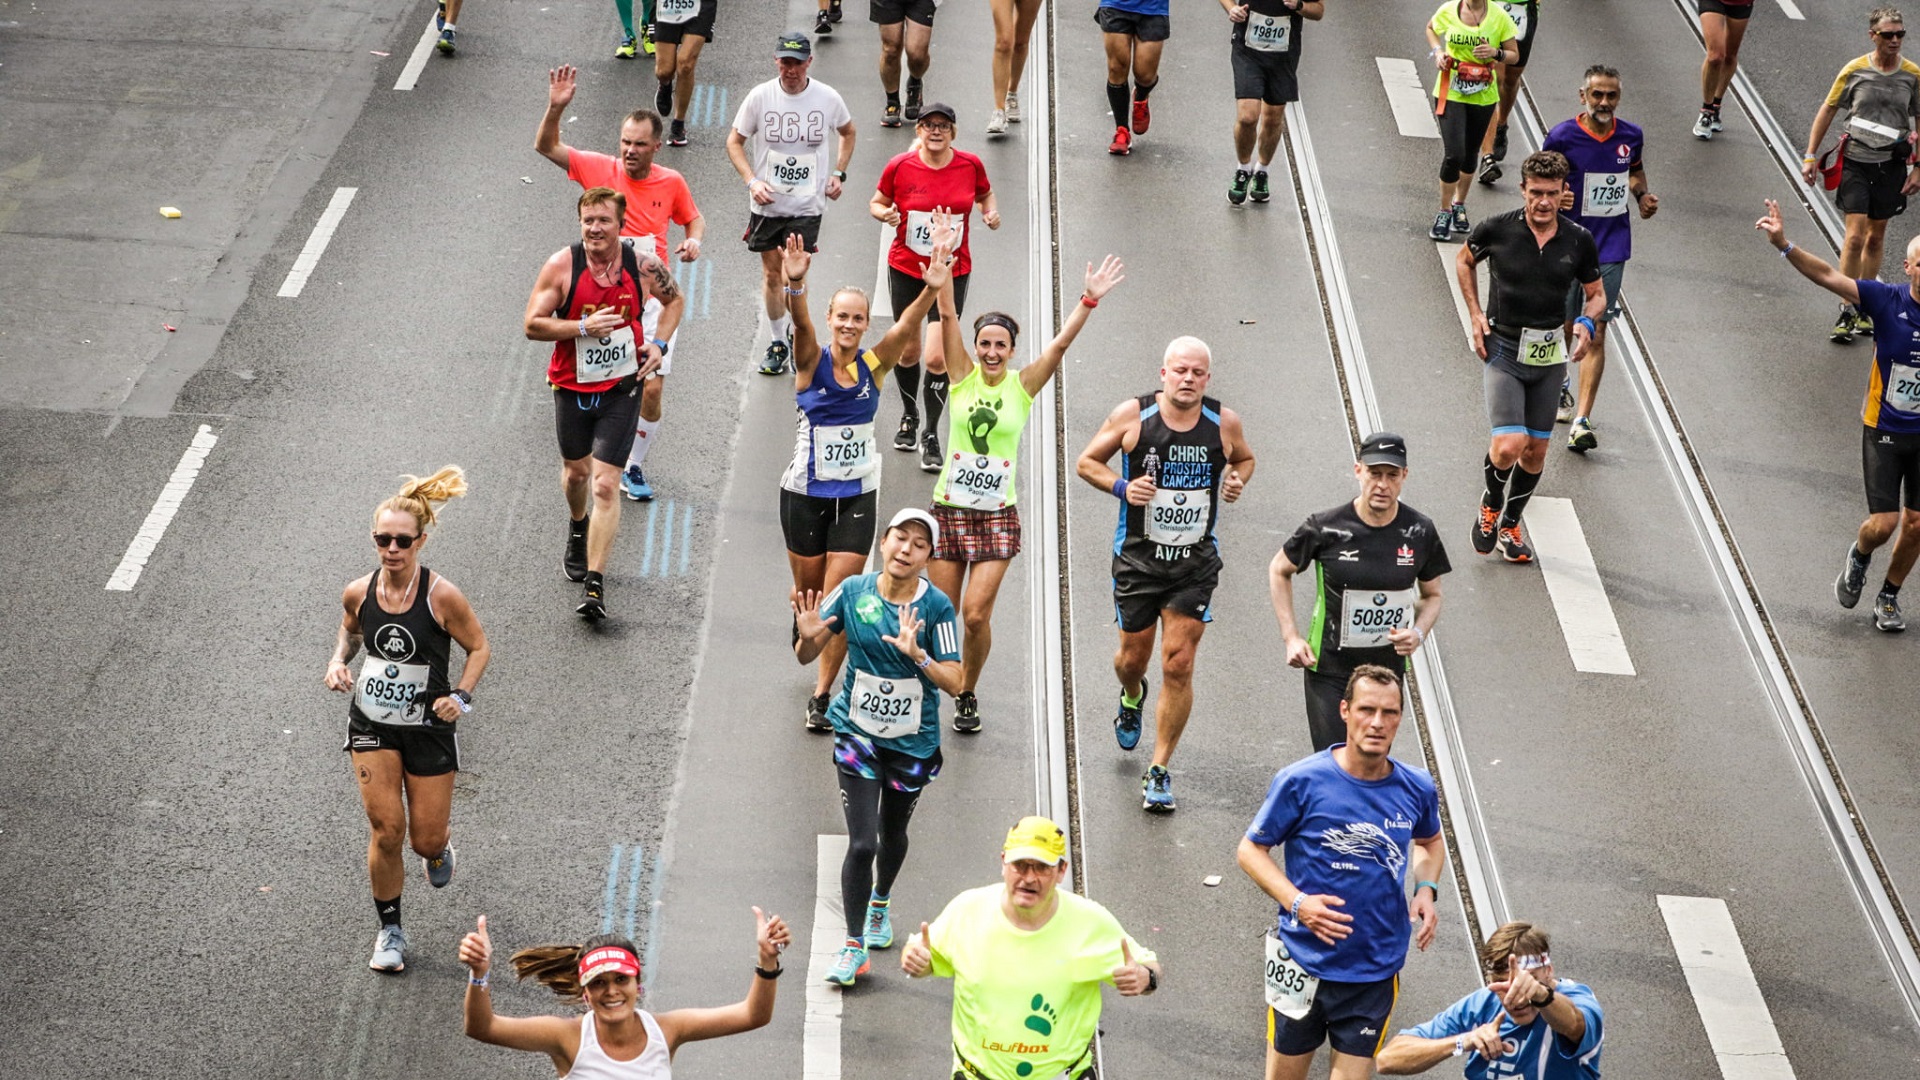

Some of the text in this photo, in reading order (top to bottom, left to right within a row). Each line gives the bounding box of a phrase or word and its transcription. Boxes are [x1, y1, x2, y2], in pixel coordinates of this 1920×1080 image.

[1253, 25, 1285, 39] 19810
[764, 111, 825, 143] 26.2
[774, 165, 810, 181] 19858
[1592, 186, 1626, 201] 17365
[585, 343, 626, 365] 32061
[824, 441, 867, 462] 37631
[1168, 445, 1208, 463] CHRIS
[1163, 461, 1212, 476] PROSTATE
[955, 467, 1002, 491] 29694
[1154, 506, 1202, 525] 39801
[1159, 524, 1194, 533] Christopher
[1352, 607, 1404, 626] 50828
[365, 677, 416, 702] 69533
[374, 699, 400, 709] Sabrina
[860, 692, 912, 716] 29332
[586, 950, 626, 966] COSTA RICA
[1266, 959, 1309, 993] 0835
[981, 1037, 1050, 1054] Laufbox
